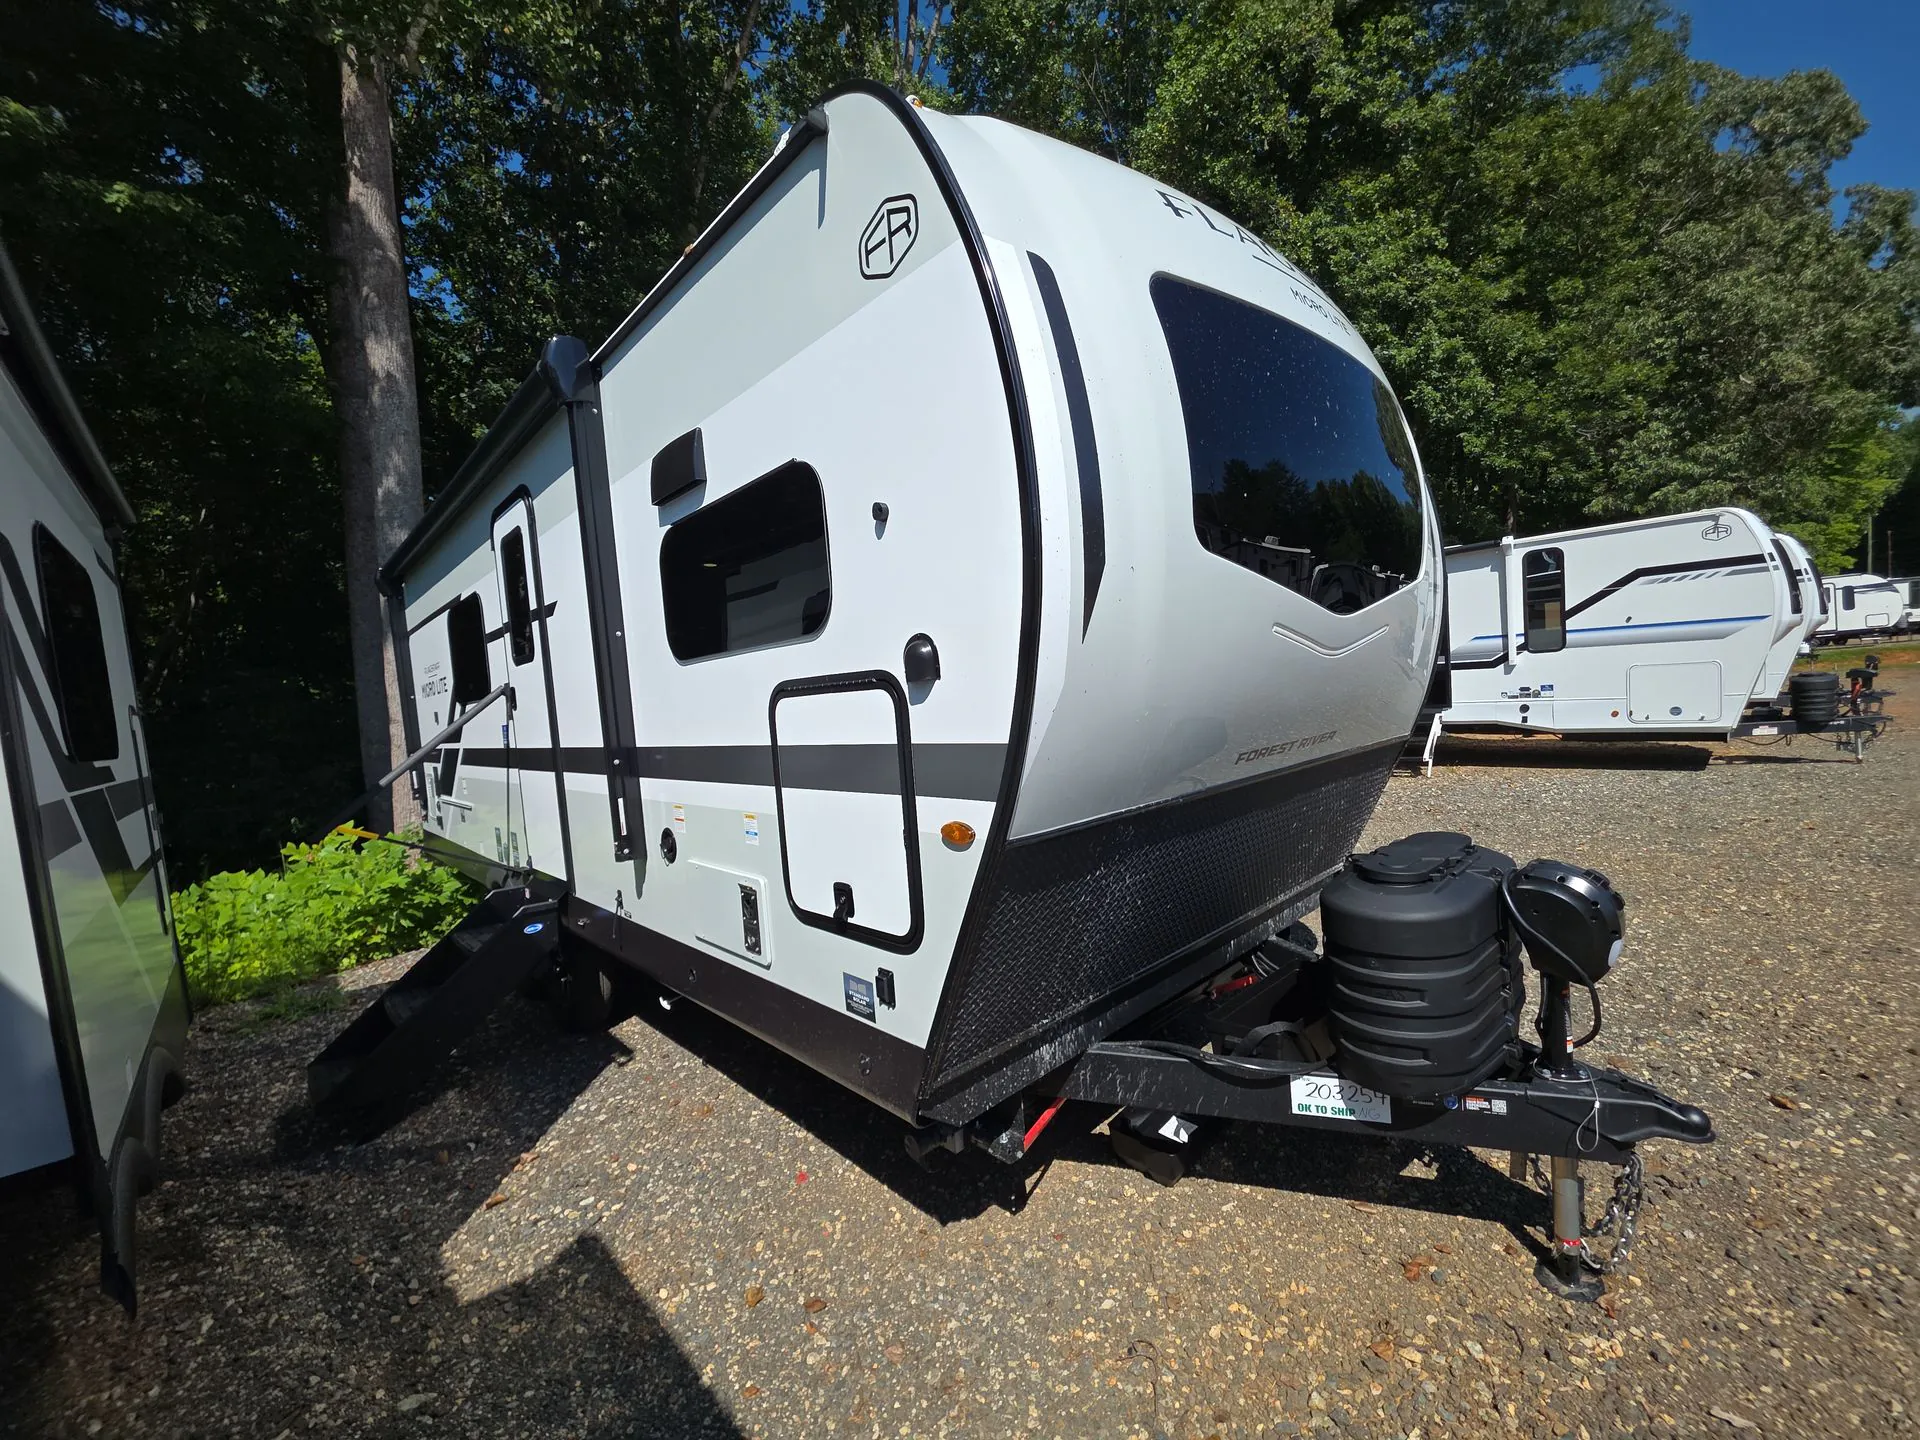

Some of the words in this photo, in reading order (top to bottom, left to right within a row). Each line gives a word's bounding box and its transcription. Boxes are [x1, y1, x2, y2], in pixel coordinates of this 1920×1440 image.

[1290, 286, 1328, 319] MICRO
[1234, 739, 1299, 765] FOREST
[1297, 730, 1337, 749] RIVER
[1305, 1082, 1388, 1106] 203254
[1297, 1103, 1313, 1113] OK
[1314, 1104, 1328, 1115] TO
[1330, 1106, 1356, 1117] SHIP
